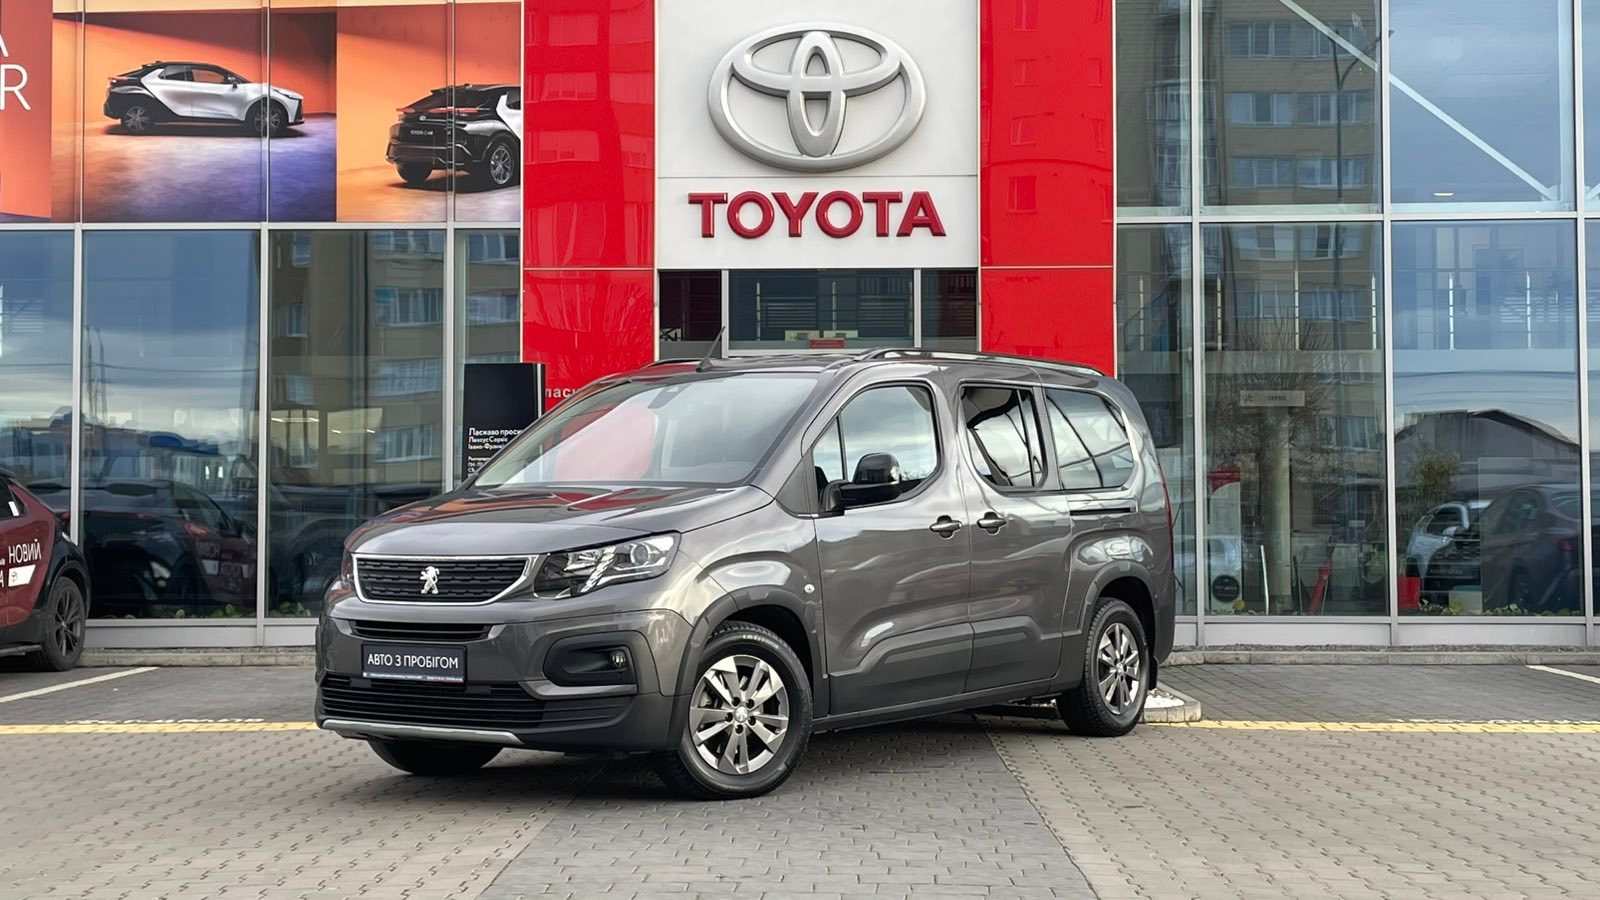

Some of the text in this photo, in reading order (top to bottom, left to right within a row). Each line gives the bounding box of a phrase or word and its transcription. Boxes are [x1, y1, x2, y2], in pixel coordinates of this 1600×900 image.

[687, 190, 948, 239] TOYOTA
[468, 427, 500, 437] Ласкаво
[8, 538, 42, 564] НОВИЙ
[367, 653, 393, 667] АВТО
[403, 655, 459, 669] ПРОБІГОМ
